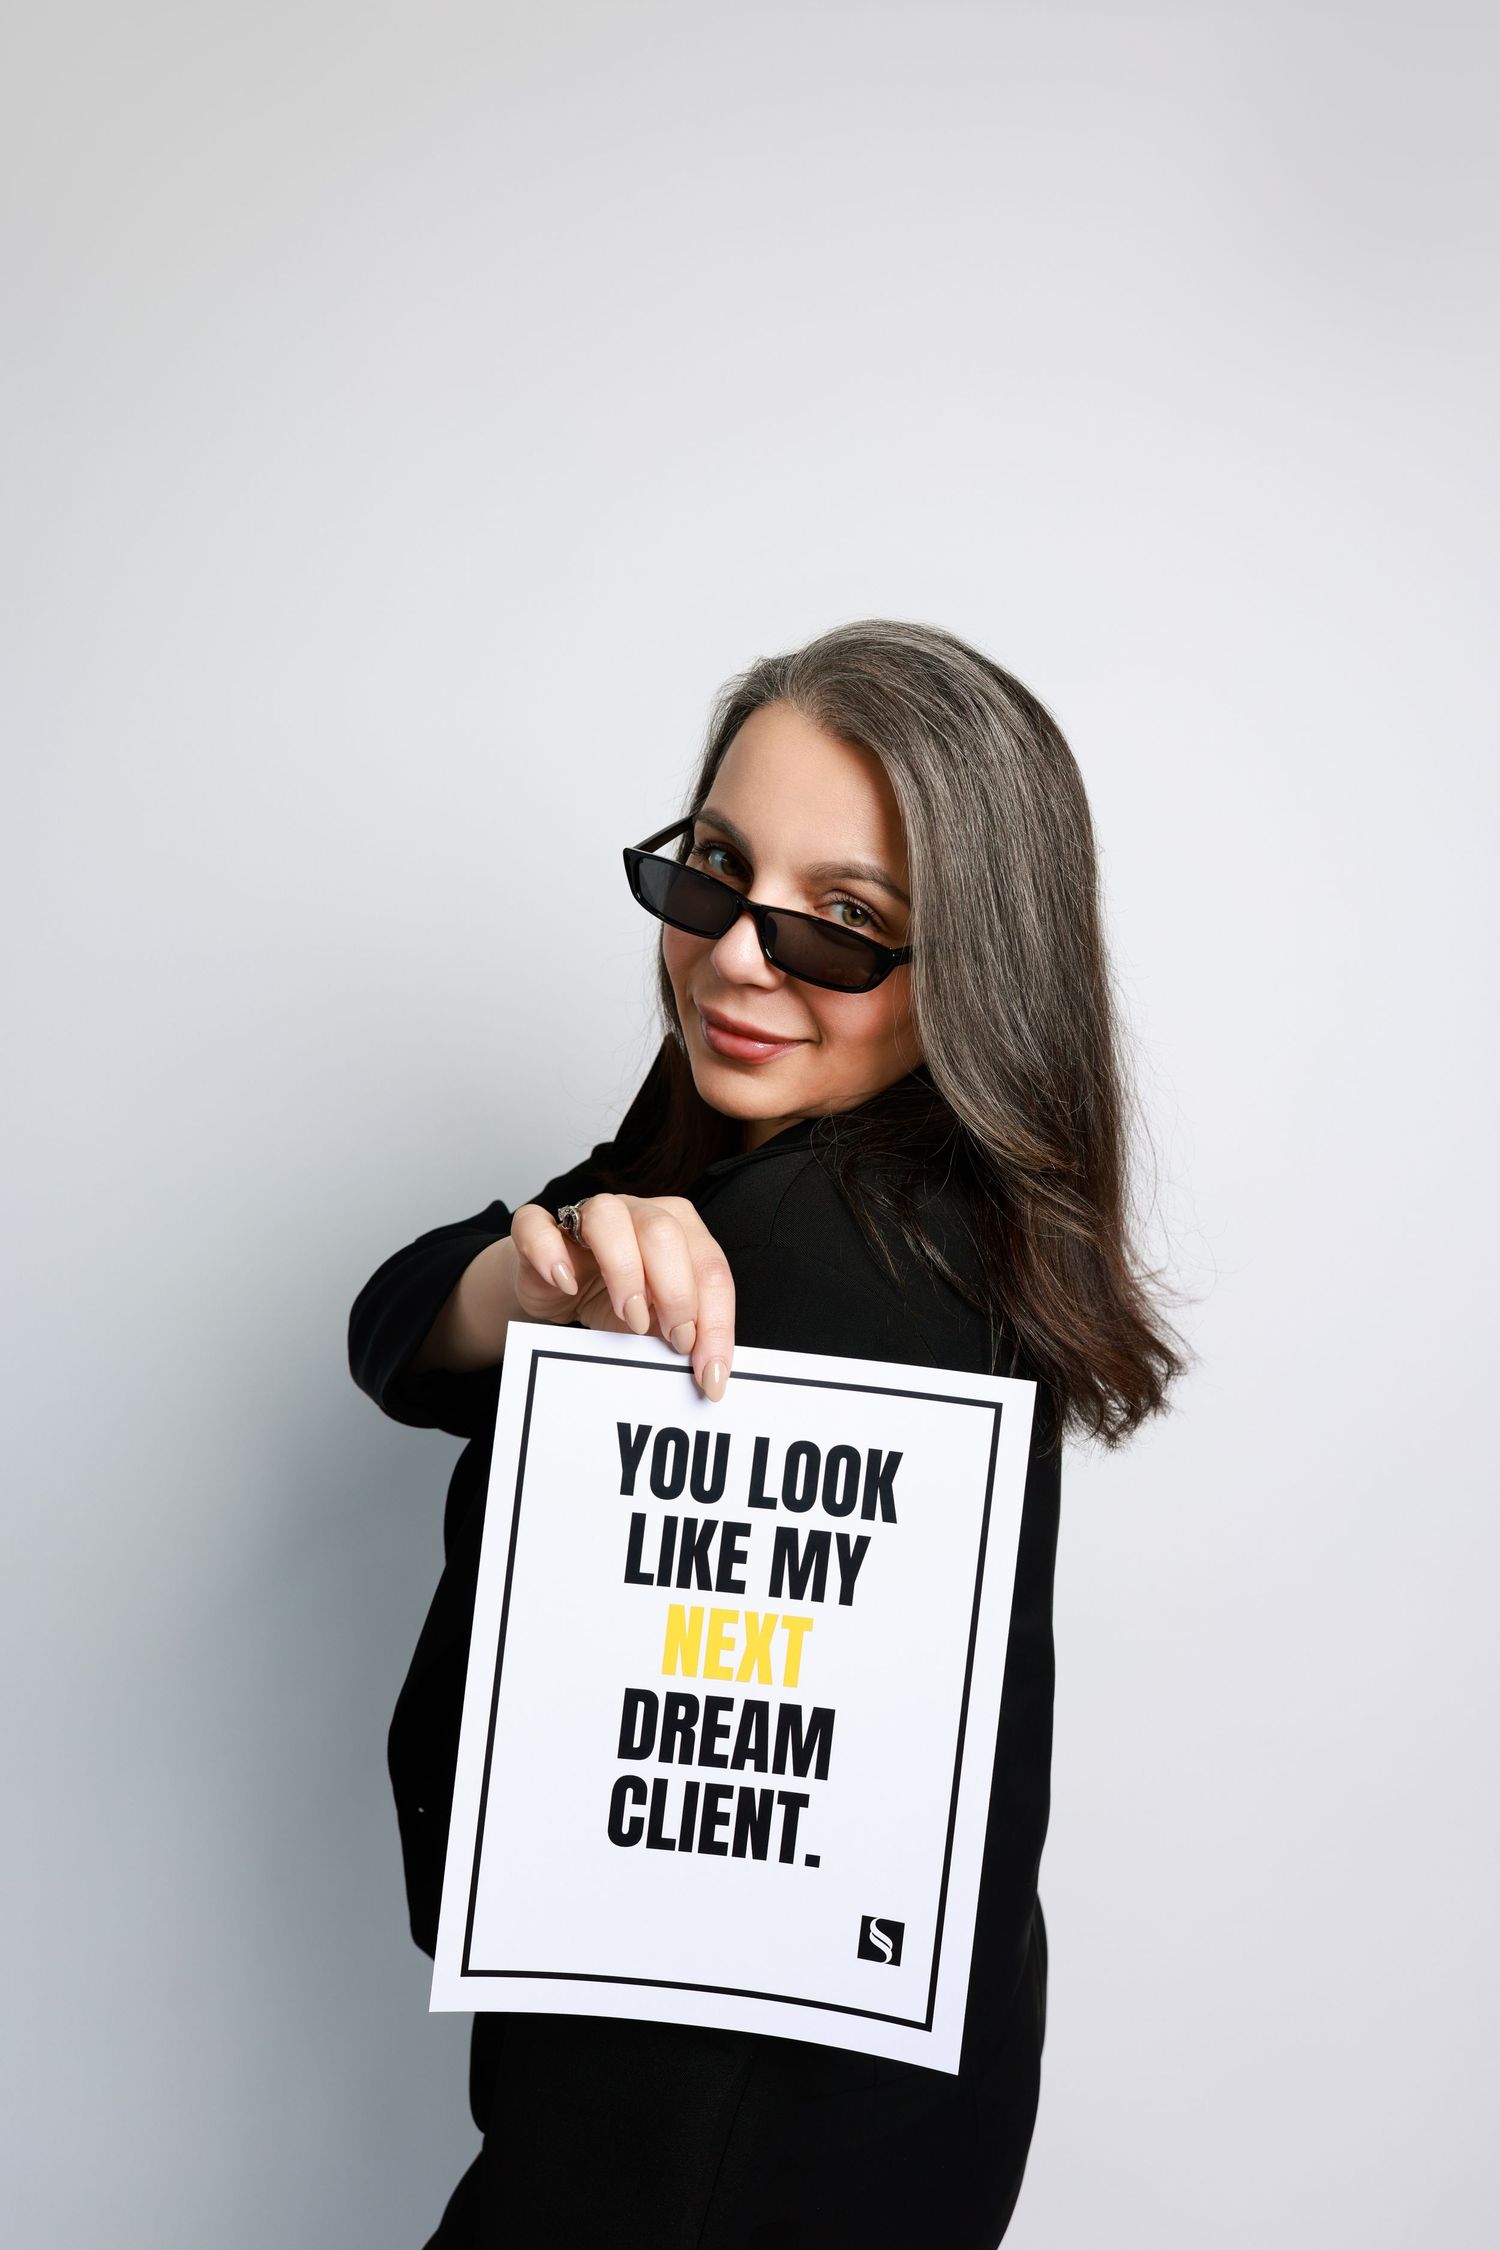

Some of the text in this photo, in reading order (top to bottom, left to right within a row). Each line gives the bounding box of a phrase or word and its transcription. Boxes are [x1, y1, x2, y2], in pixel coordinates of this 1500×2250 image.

[616, 1422, 904, 1523] YOU LOOK
[623, 1512, 872, 1606] LIKE MY
[661, 1605, 814, 1688] NEXT
[617, 1688, 836, 1780] DREAM
[607, 1775, 821, 1869] CLIENT.
